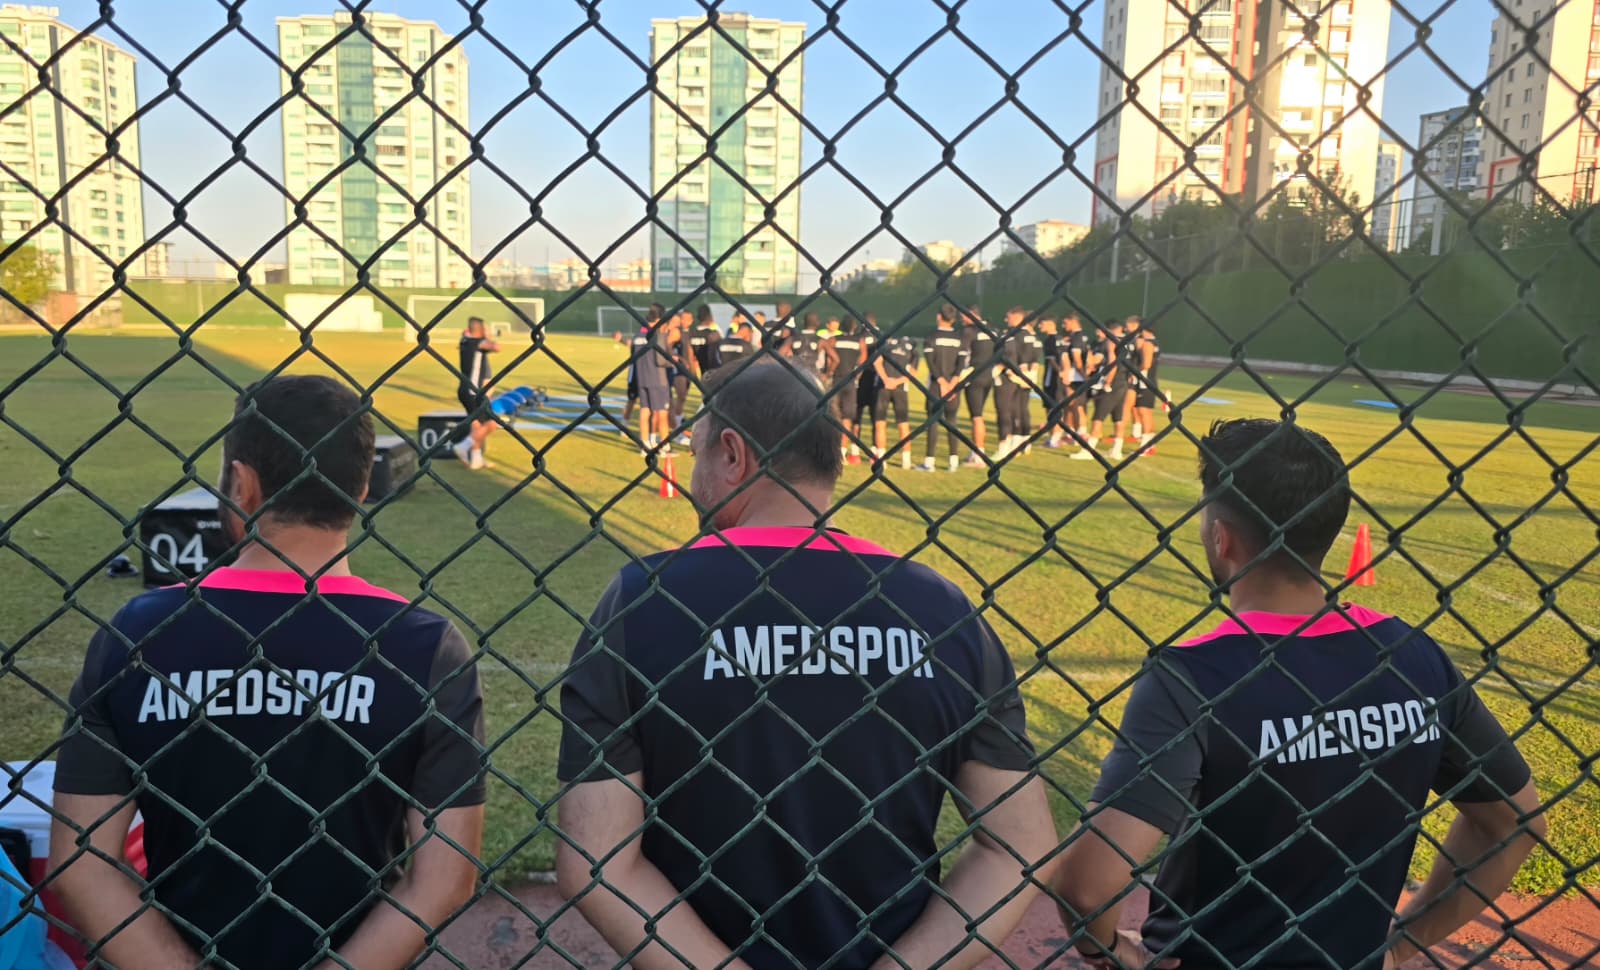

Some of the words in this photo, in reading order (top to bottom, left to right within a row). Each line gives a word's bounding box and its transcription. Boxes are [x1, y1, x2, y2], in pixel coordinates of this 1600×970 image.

[150, 532, 208, 574] 04
[703, 625, 934, 679] AMEDSPOR
[138, 669, 376, 724] AMEDSPOR
